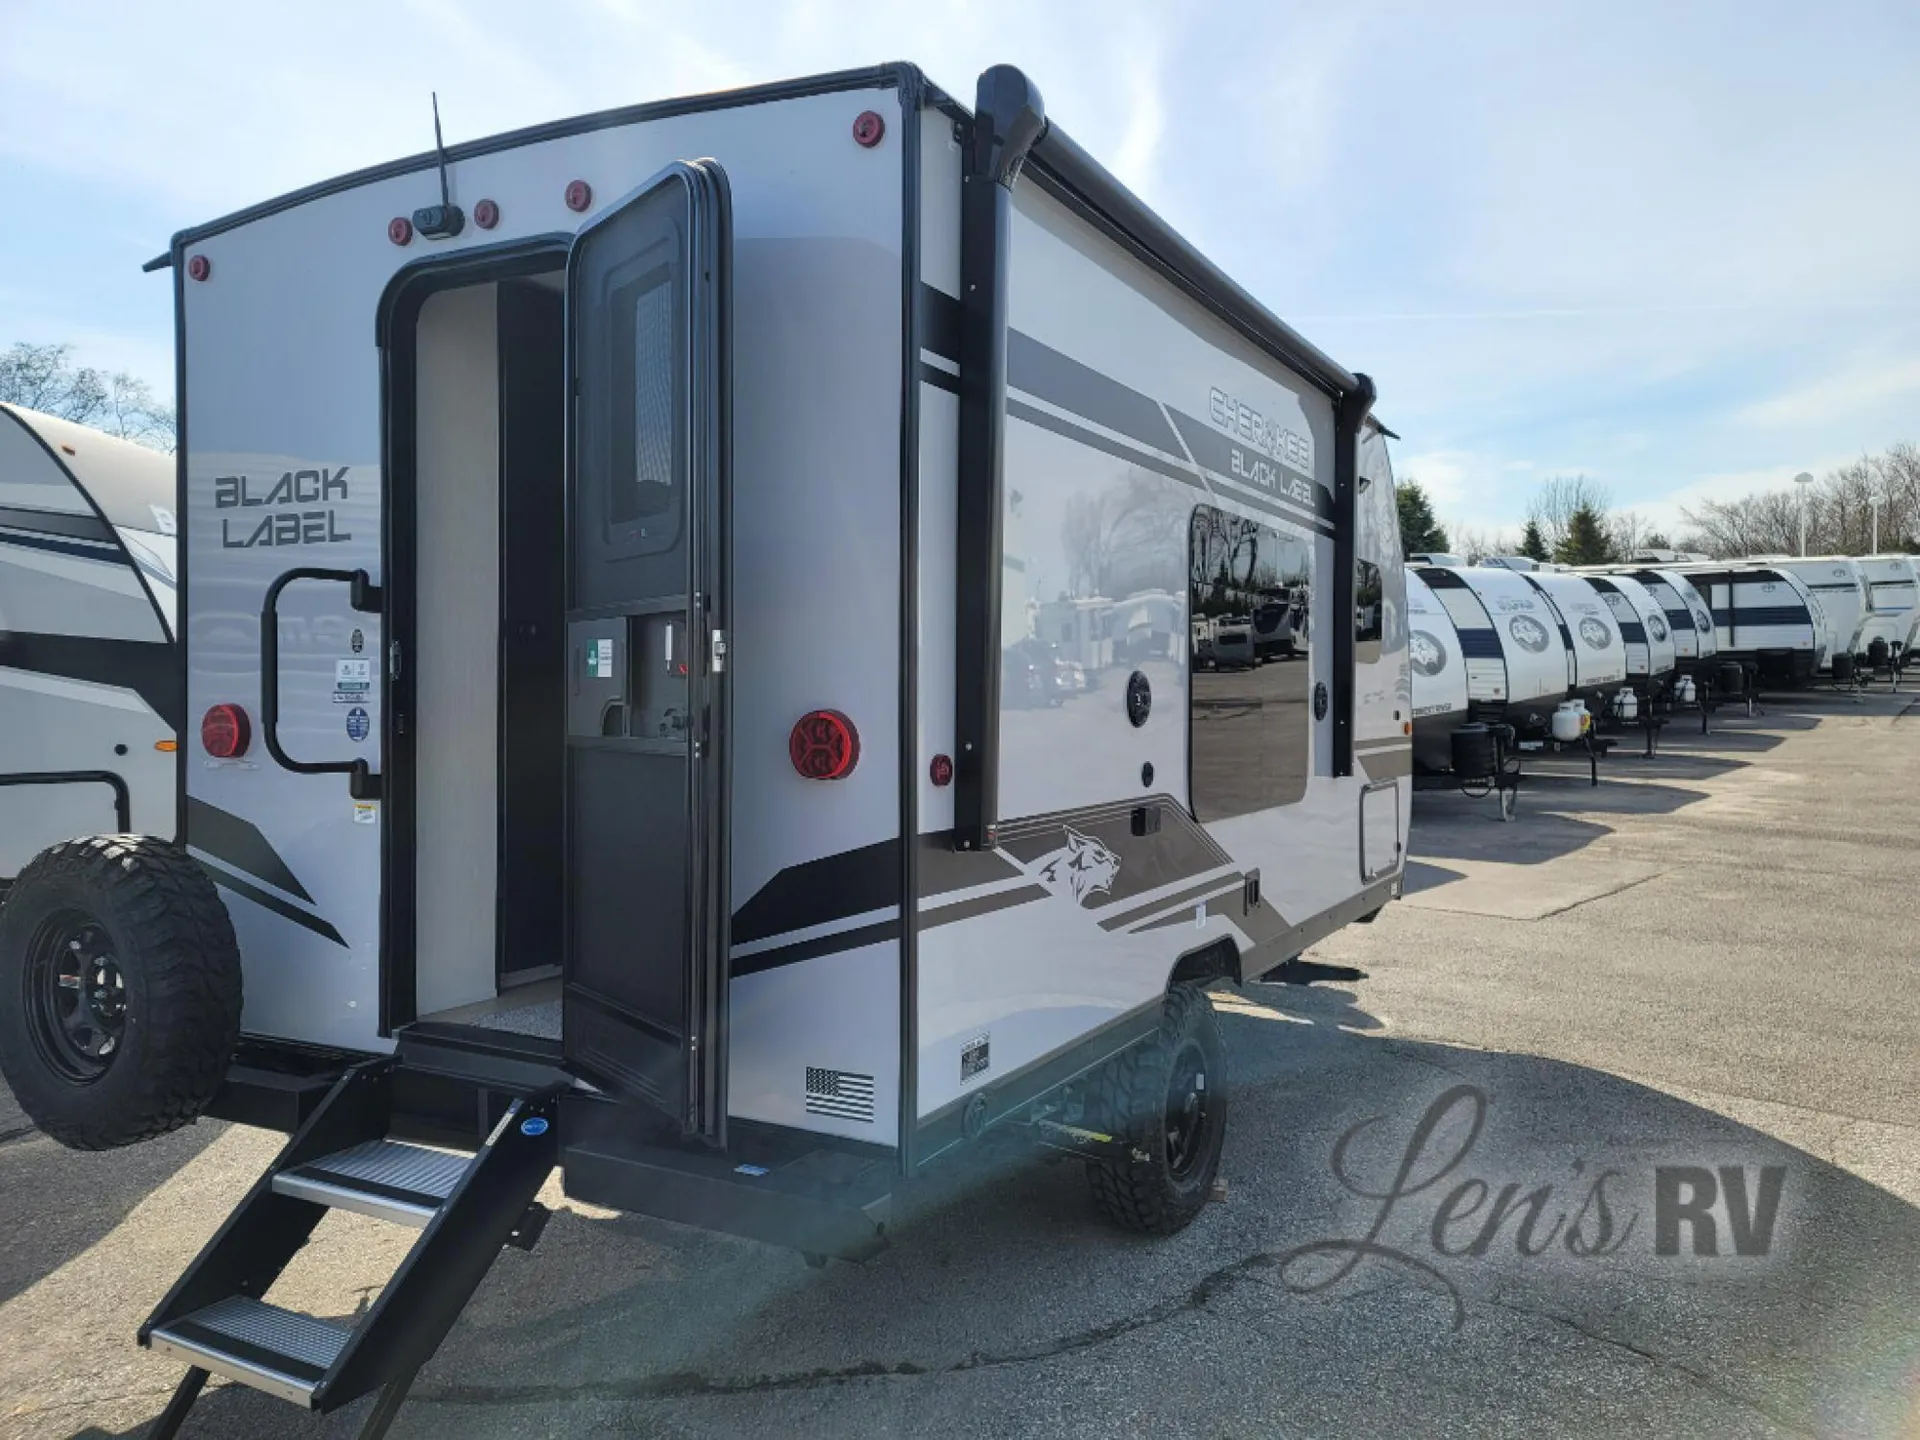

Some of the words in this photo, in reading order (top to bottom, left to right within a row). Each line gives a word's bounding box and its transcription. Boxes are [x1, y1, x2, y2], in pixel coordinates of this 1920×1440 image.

[215, 466, 350, 508] BLACK
[1231, 448, 1277, 489] BLACK
[1280, 472, 1316, 507] LABEL
[222, 510, 352, 548] LABEL
